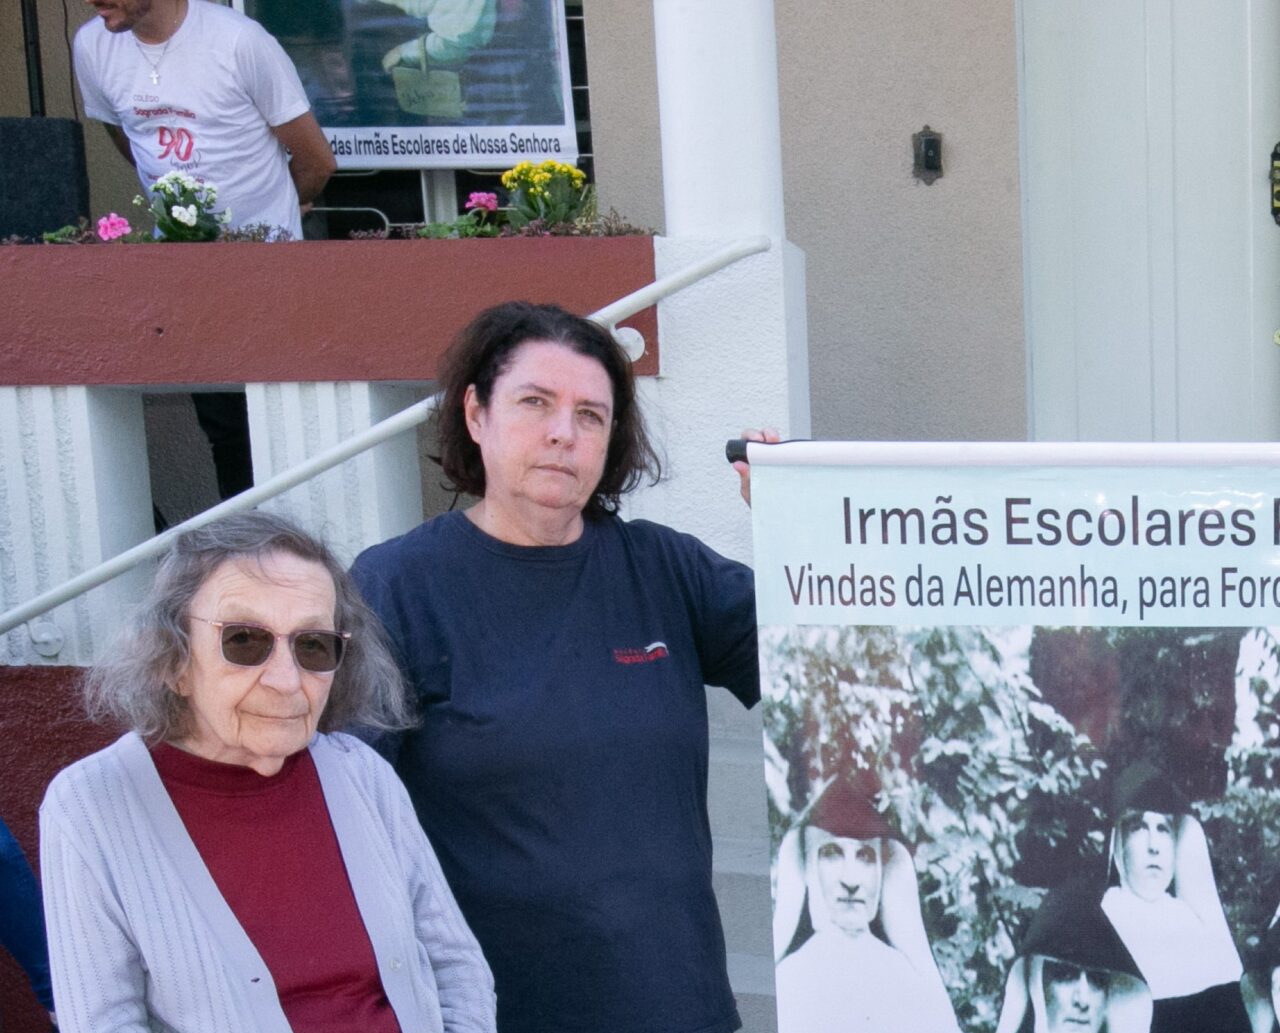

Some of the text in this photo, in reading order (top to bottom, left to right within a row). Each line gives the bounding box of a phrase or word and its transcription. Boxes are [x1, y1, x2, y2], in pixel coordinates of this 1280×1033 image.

[158, 126, 194, 162] 90
[330, 131, 561, 156] das Irmãs Escolares de Nossa Senhora
[843, 495, 989, 546] Irmãs
[1005, 495, 1257, 547] Escolares
[784, 563, 896, 607] Vindas
[905, 564, 944, 607] da
[954, 563, 1128, 615] Alemanha,
[1139, 573, 1210, 621] para
